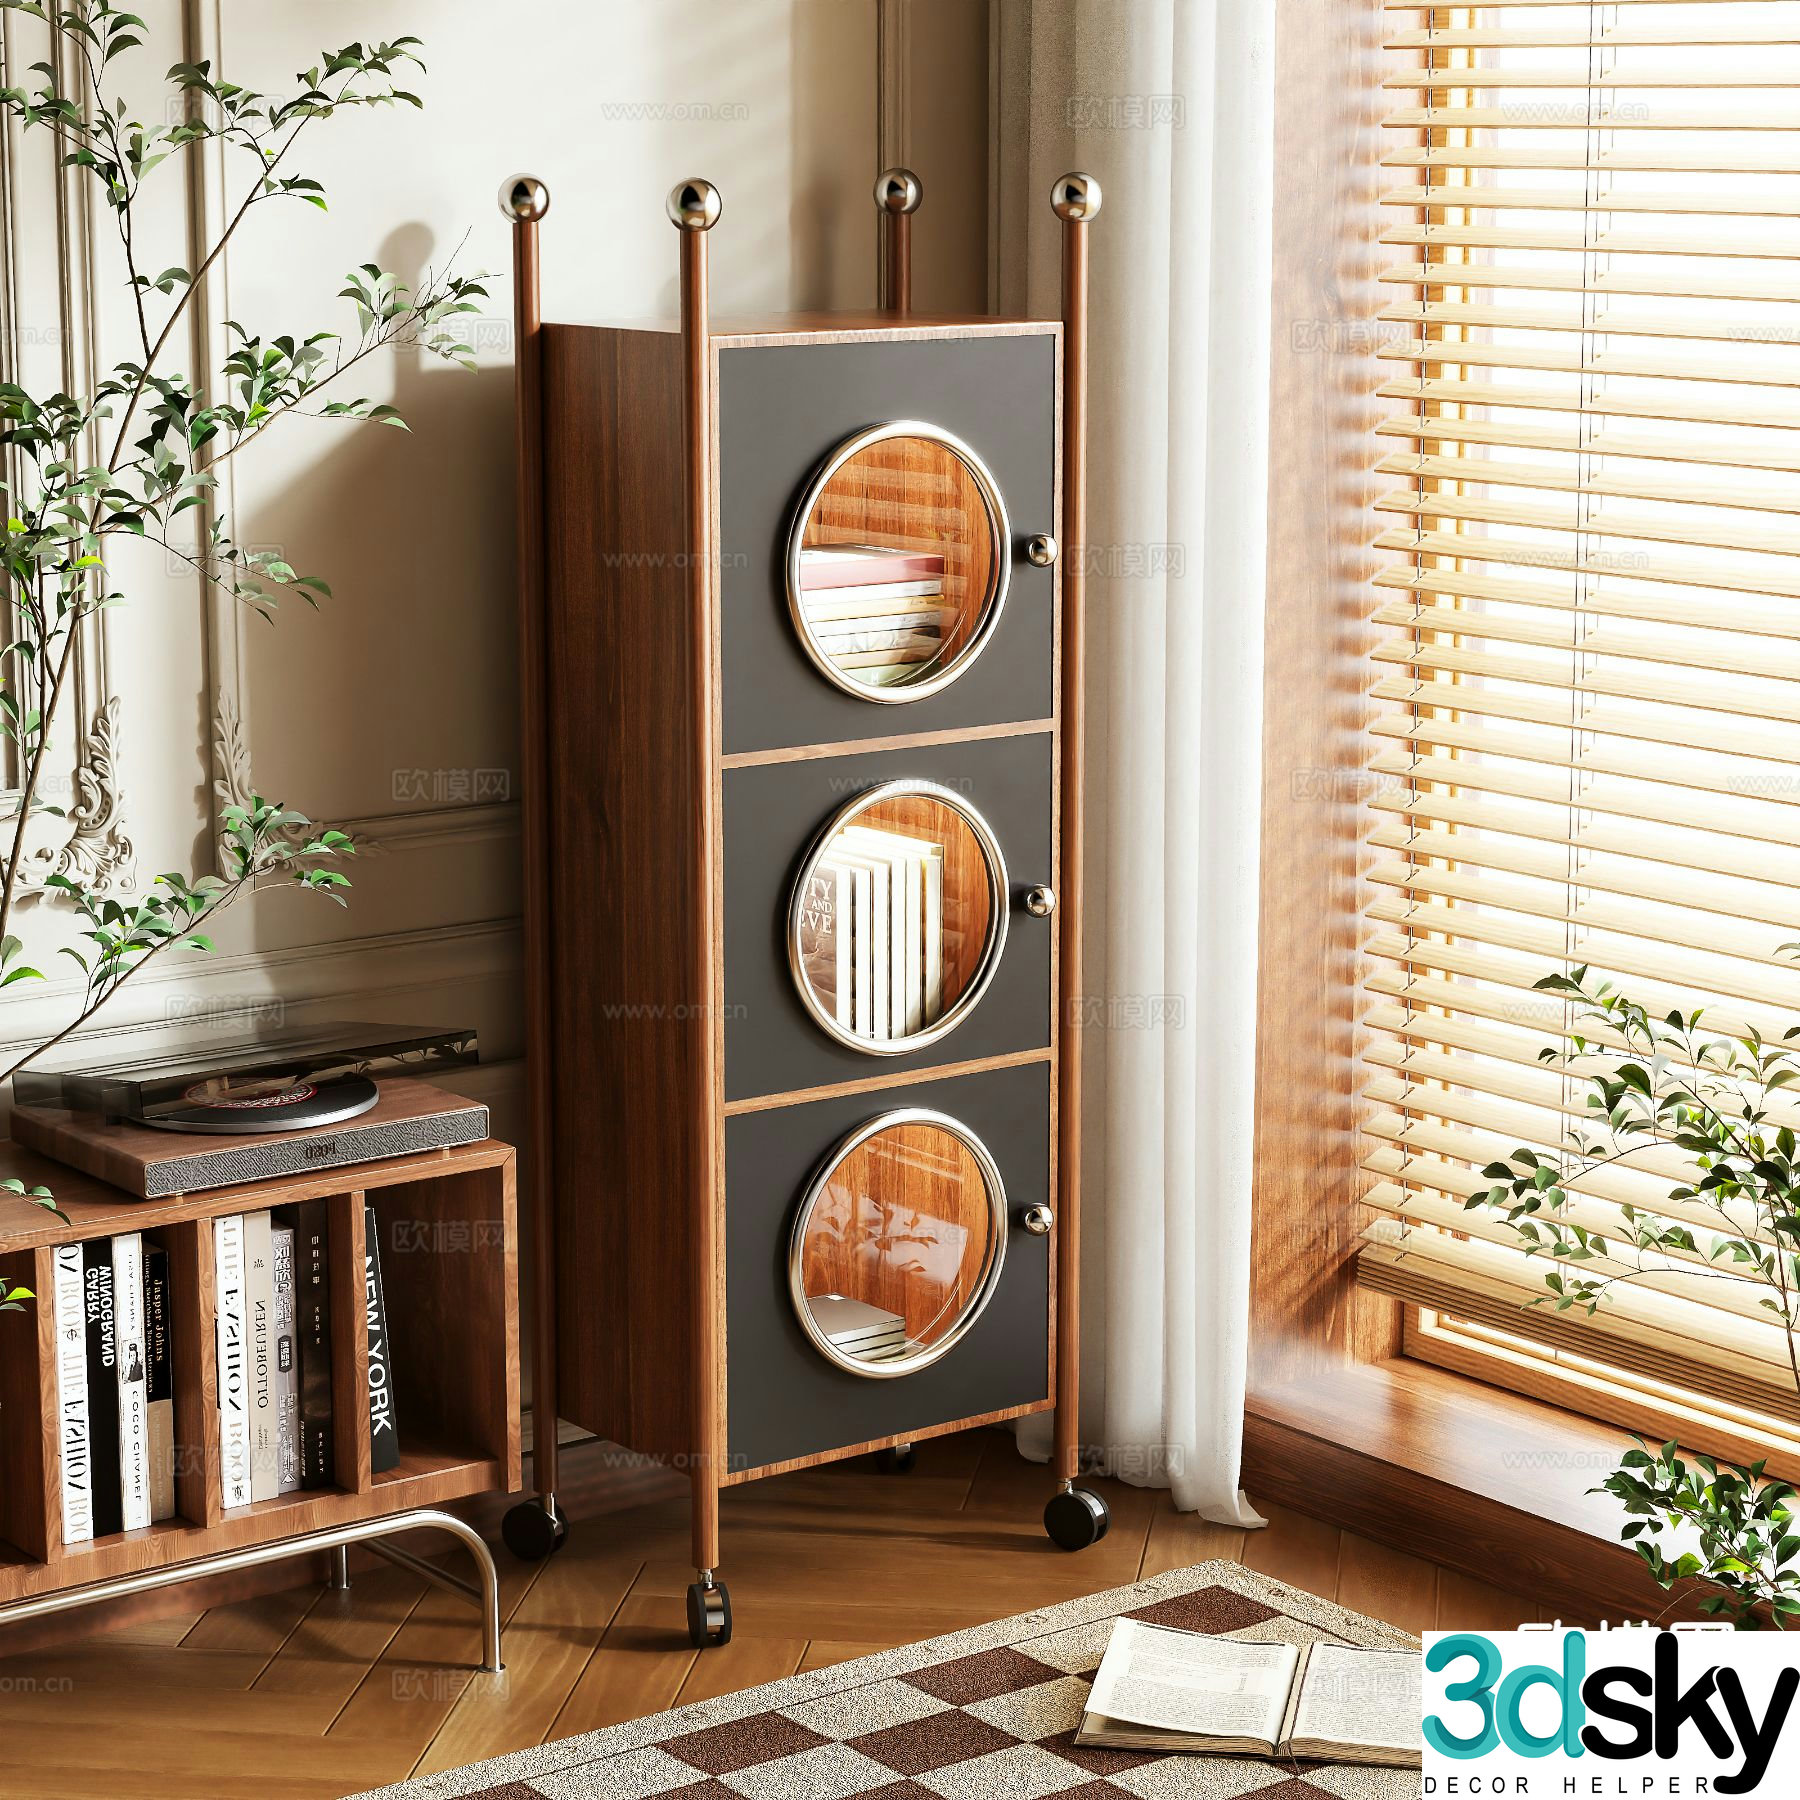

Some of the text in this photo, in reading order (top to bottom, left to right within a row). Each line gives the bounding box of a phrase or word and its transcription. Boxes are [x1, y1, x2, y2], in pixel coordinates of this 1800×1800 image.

[811, 900, 832, 912] AND
[153, 1279, 164, 1361] Jasper Johns
[368, 1338, 392, 1436] YORK
